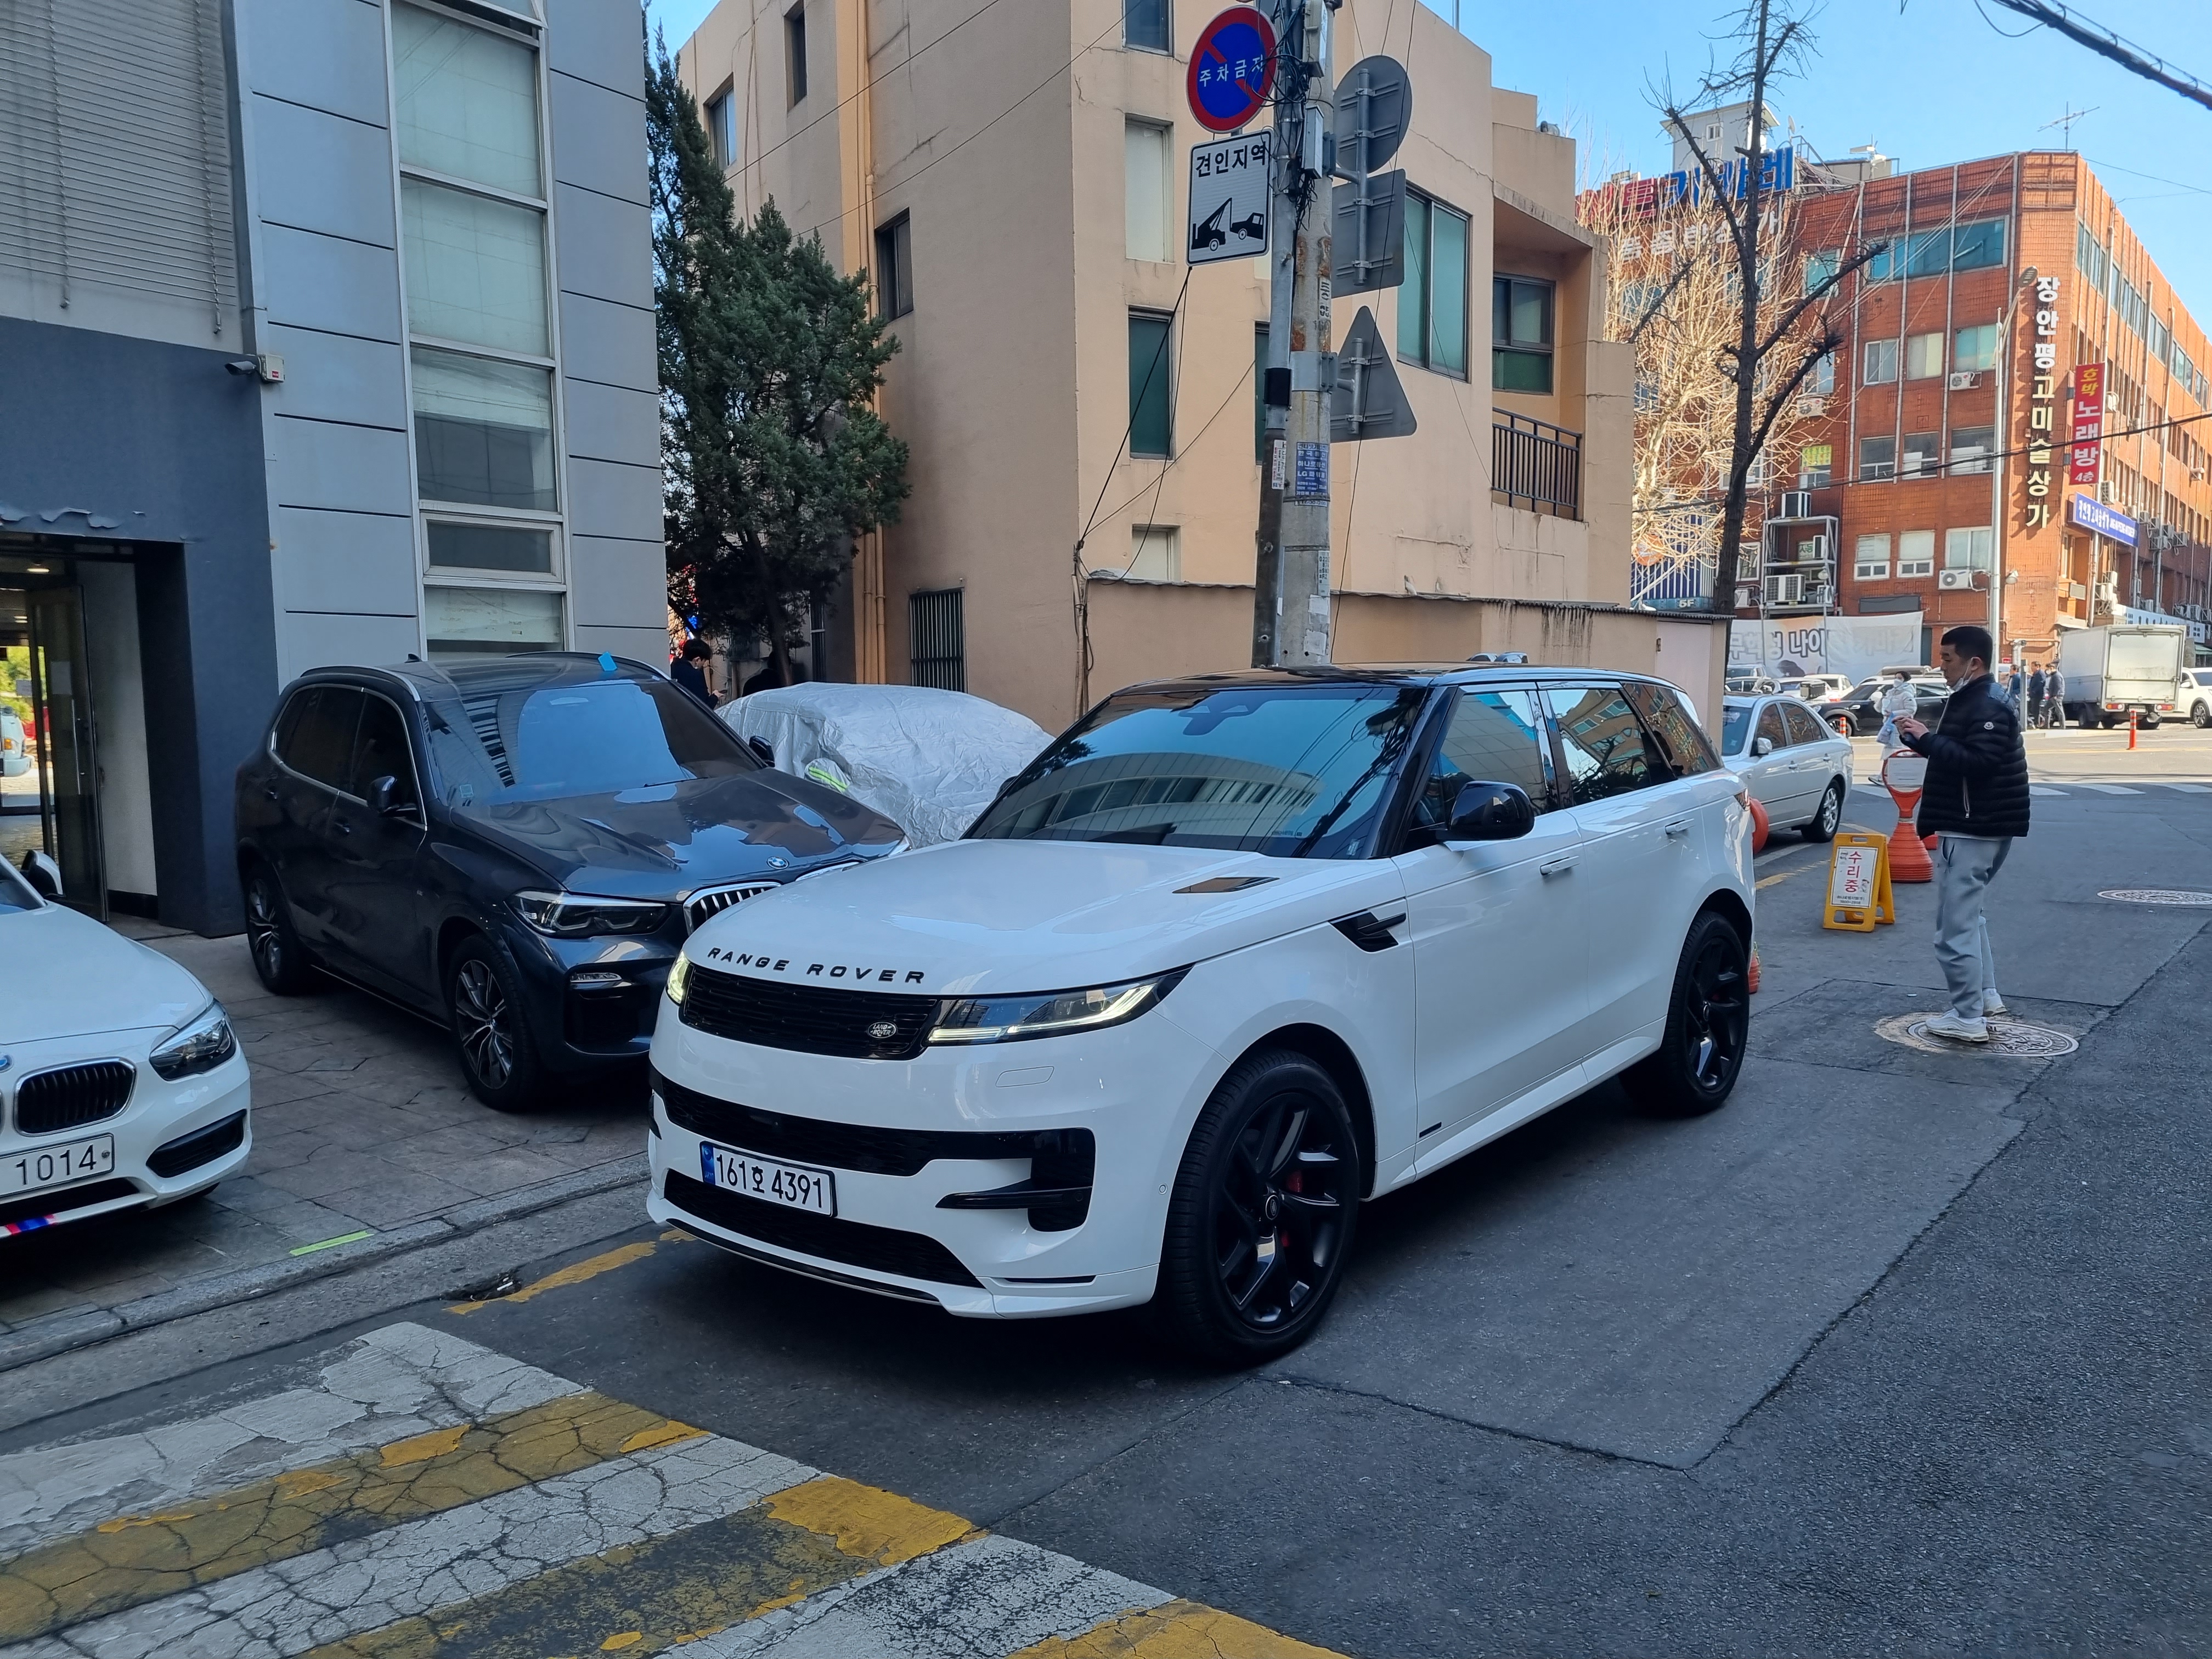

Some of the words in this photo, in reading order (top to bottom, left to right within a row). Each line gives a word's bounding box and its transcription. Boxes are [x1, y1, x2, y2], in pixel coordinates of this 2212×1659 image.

[1196, 141, 1266, 178] 견인지역
[2074, 401, 2101, 467] 노래방
[1678, 599, 1695, 608] 5F
[1844, 851, 1863, 893] 수리중
[708, 947, 789, 971] RANGE
[806, 964, 925, 984] ROVER
[15, 1144, 96, 1186] 1014
[716, 1154, 765, 1194] 161호
[771, 1169, 822, 1208] 4391
